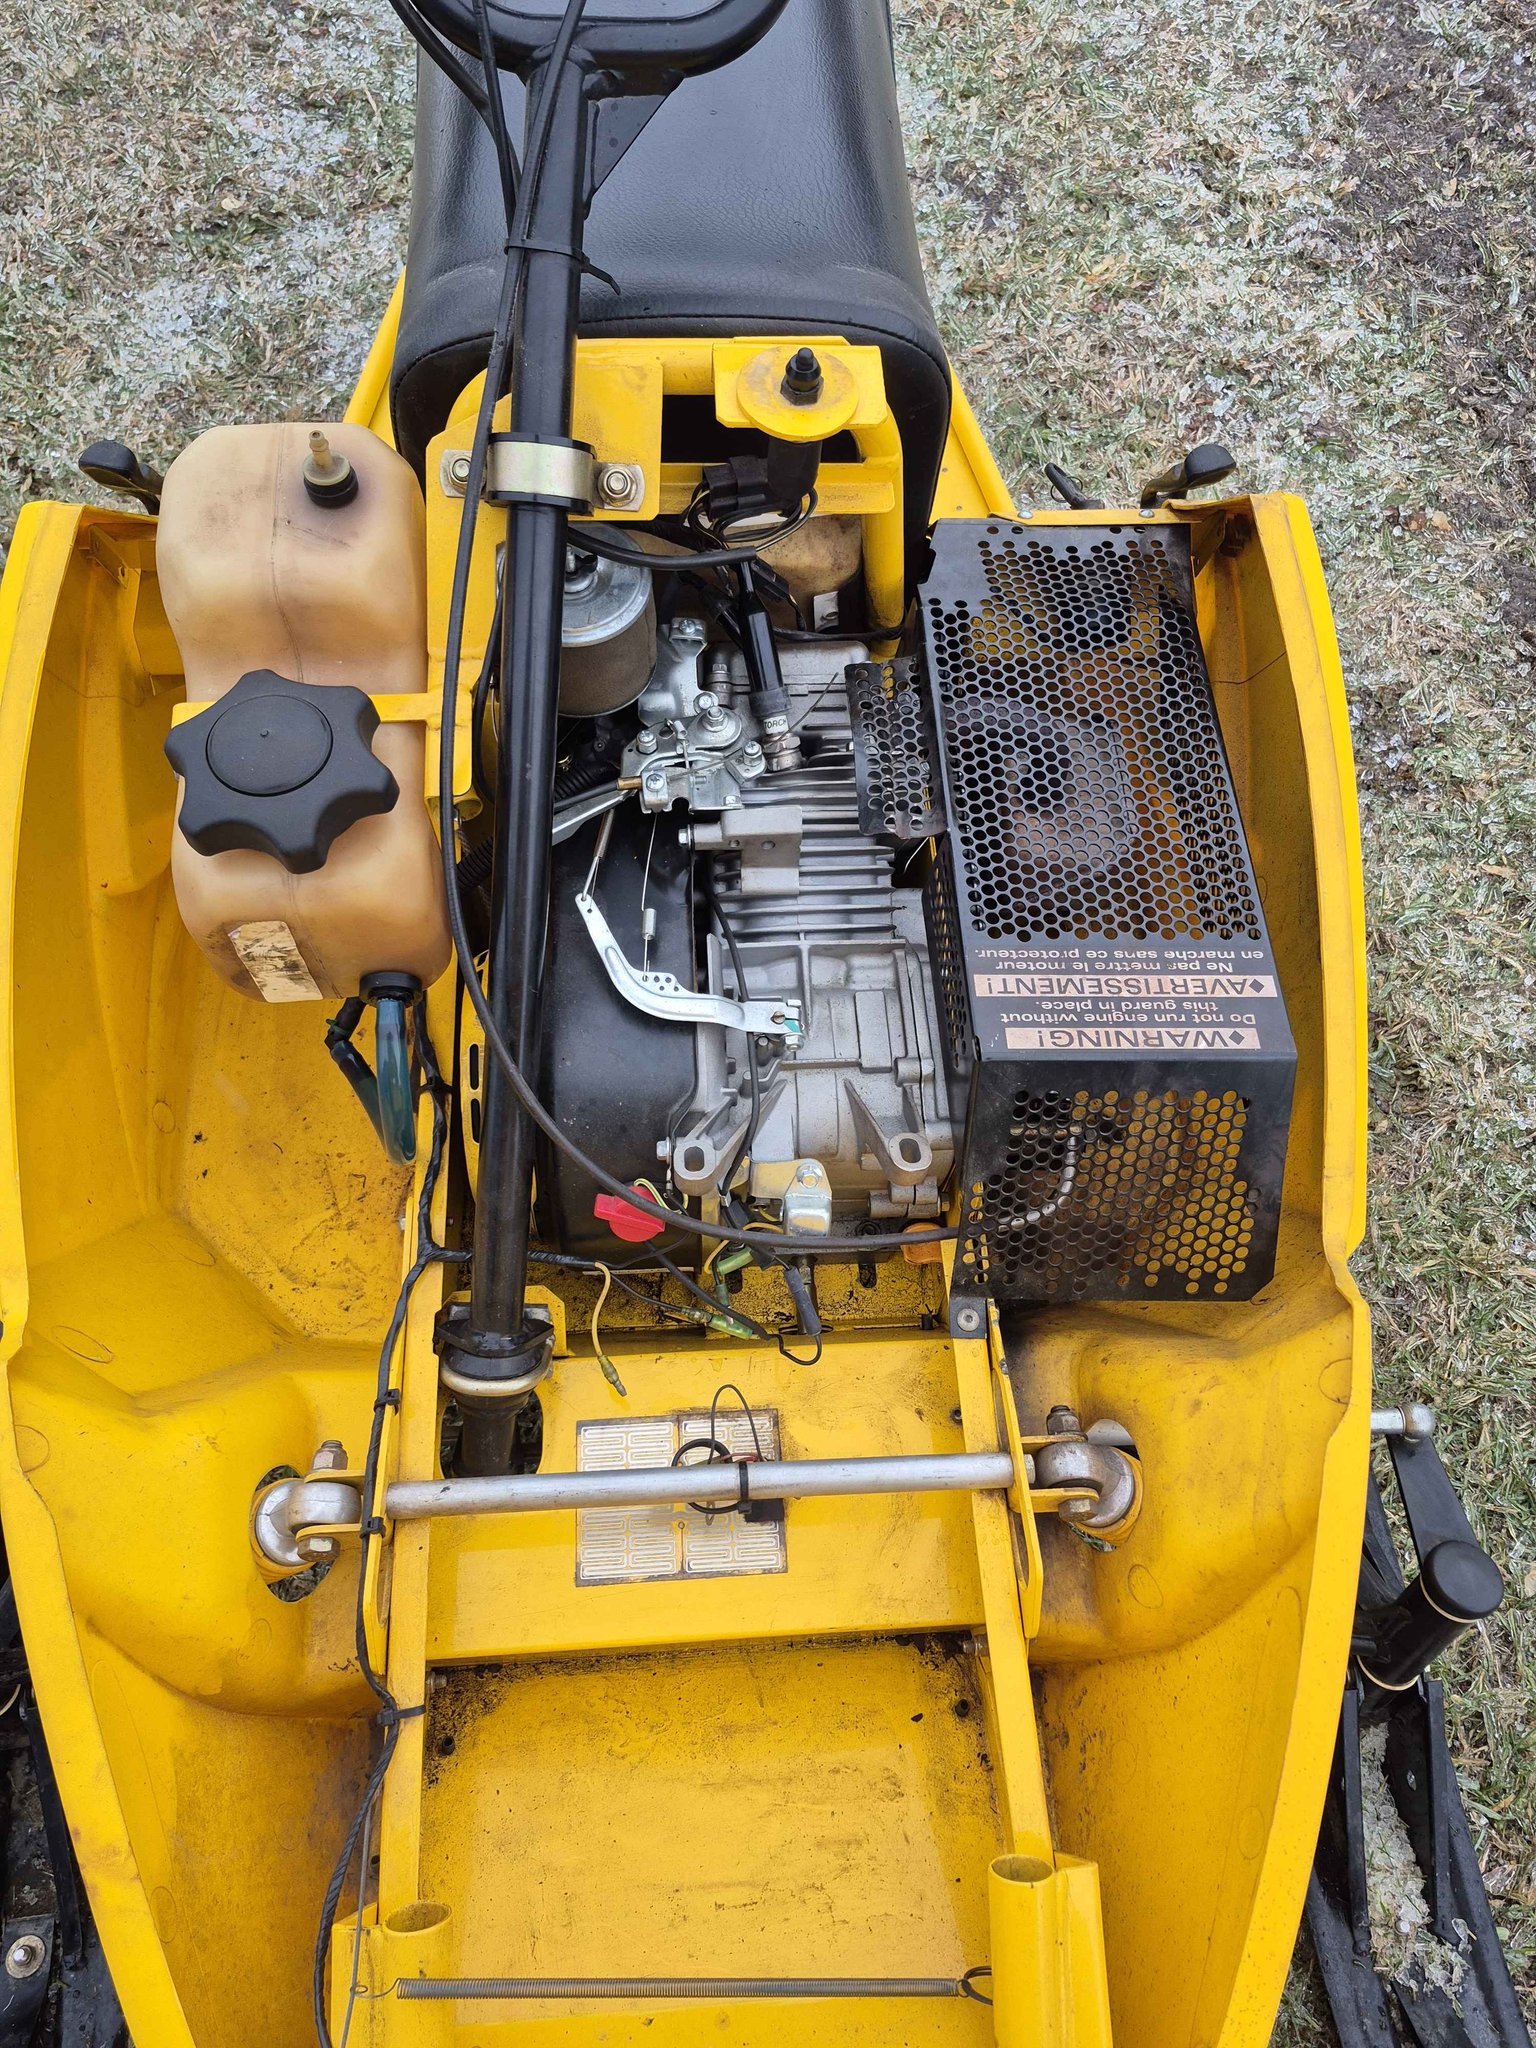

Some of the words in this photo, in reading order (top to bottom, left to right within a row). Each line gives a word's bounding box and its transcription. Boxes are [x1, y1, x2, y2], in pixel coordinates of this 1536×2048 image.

[975, 949, 1079, 959] protecteur.
[1114, 950, 1157, 959] sans
[1165, 951, 1235, 960] marche
[1241, 951, 1263, 959] en
[995, 962, 1065, 971] moteur
[1073, 962, 1088, 972] le
[1095, 962, 1160, 971] mettre
[1203, 962, 1233, 972] Ne
[987, 978, 1247, 995] AVERTISSEMENT!
[1036, 999, 1092, 1012] place.
[1099, 1002, 1115, 1011] in
[1120, 1000, 1176, 1012] guard
[1183, 1002, 1218, 1012] this
[1001, 1014, 1078, 1024] without
[1084, 1010, 1148, 1024] engine
[1157, 1014, 1186, 1022] run
[1192, 1014, 1223, 1023] not
[1230, 1014, 1256, 1024] Do
[1038, 1030, 1228, 1047] WARNING!
